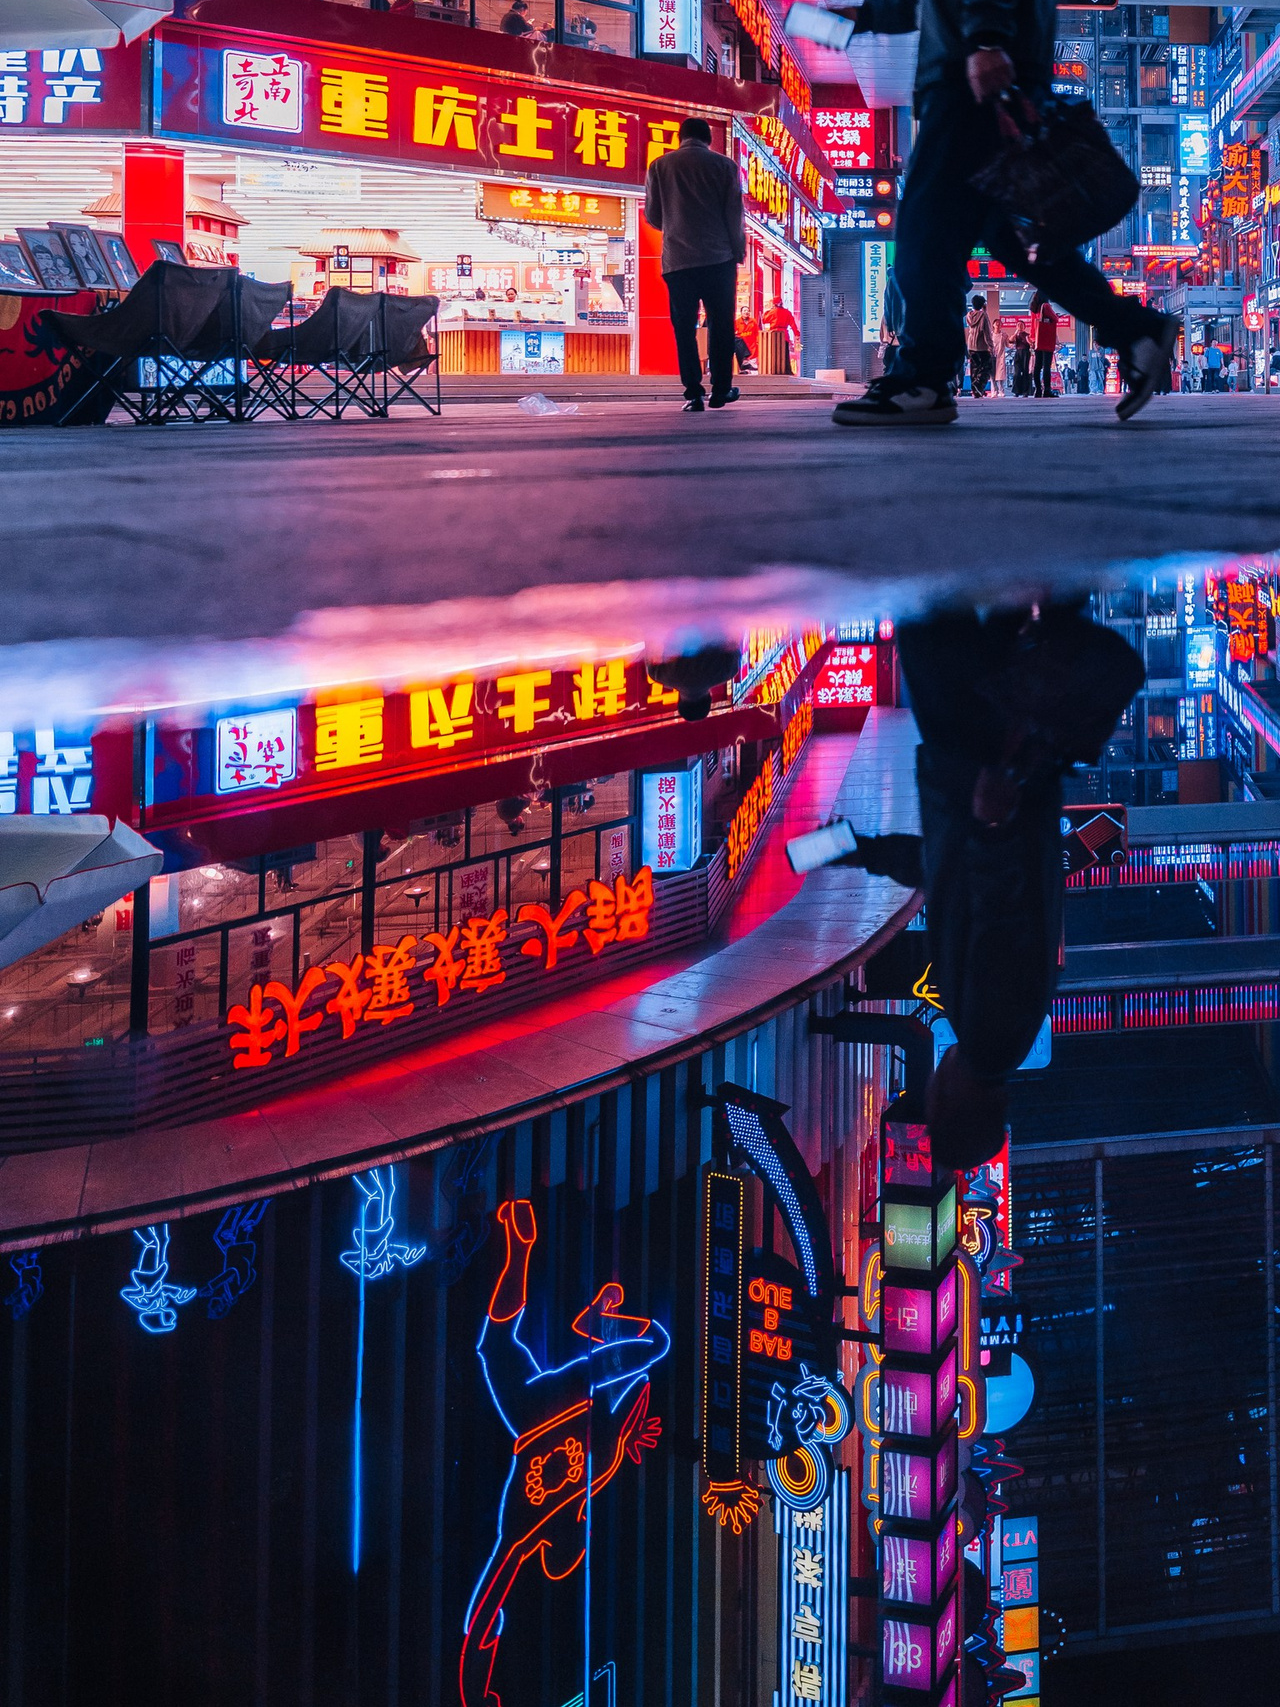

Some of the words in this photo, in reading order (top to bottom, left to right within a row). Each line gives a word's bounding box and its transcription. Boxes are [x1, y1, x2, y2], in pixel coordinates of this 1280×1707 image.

[1053, 62, 1084, 76] 乐部
[825, 128, 861, 146] 火锅
[868, 243, 882, 268] 全家
[868, 268, 881, 322] FamilyMart
